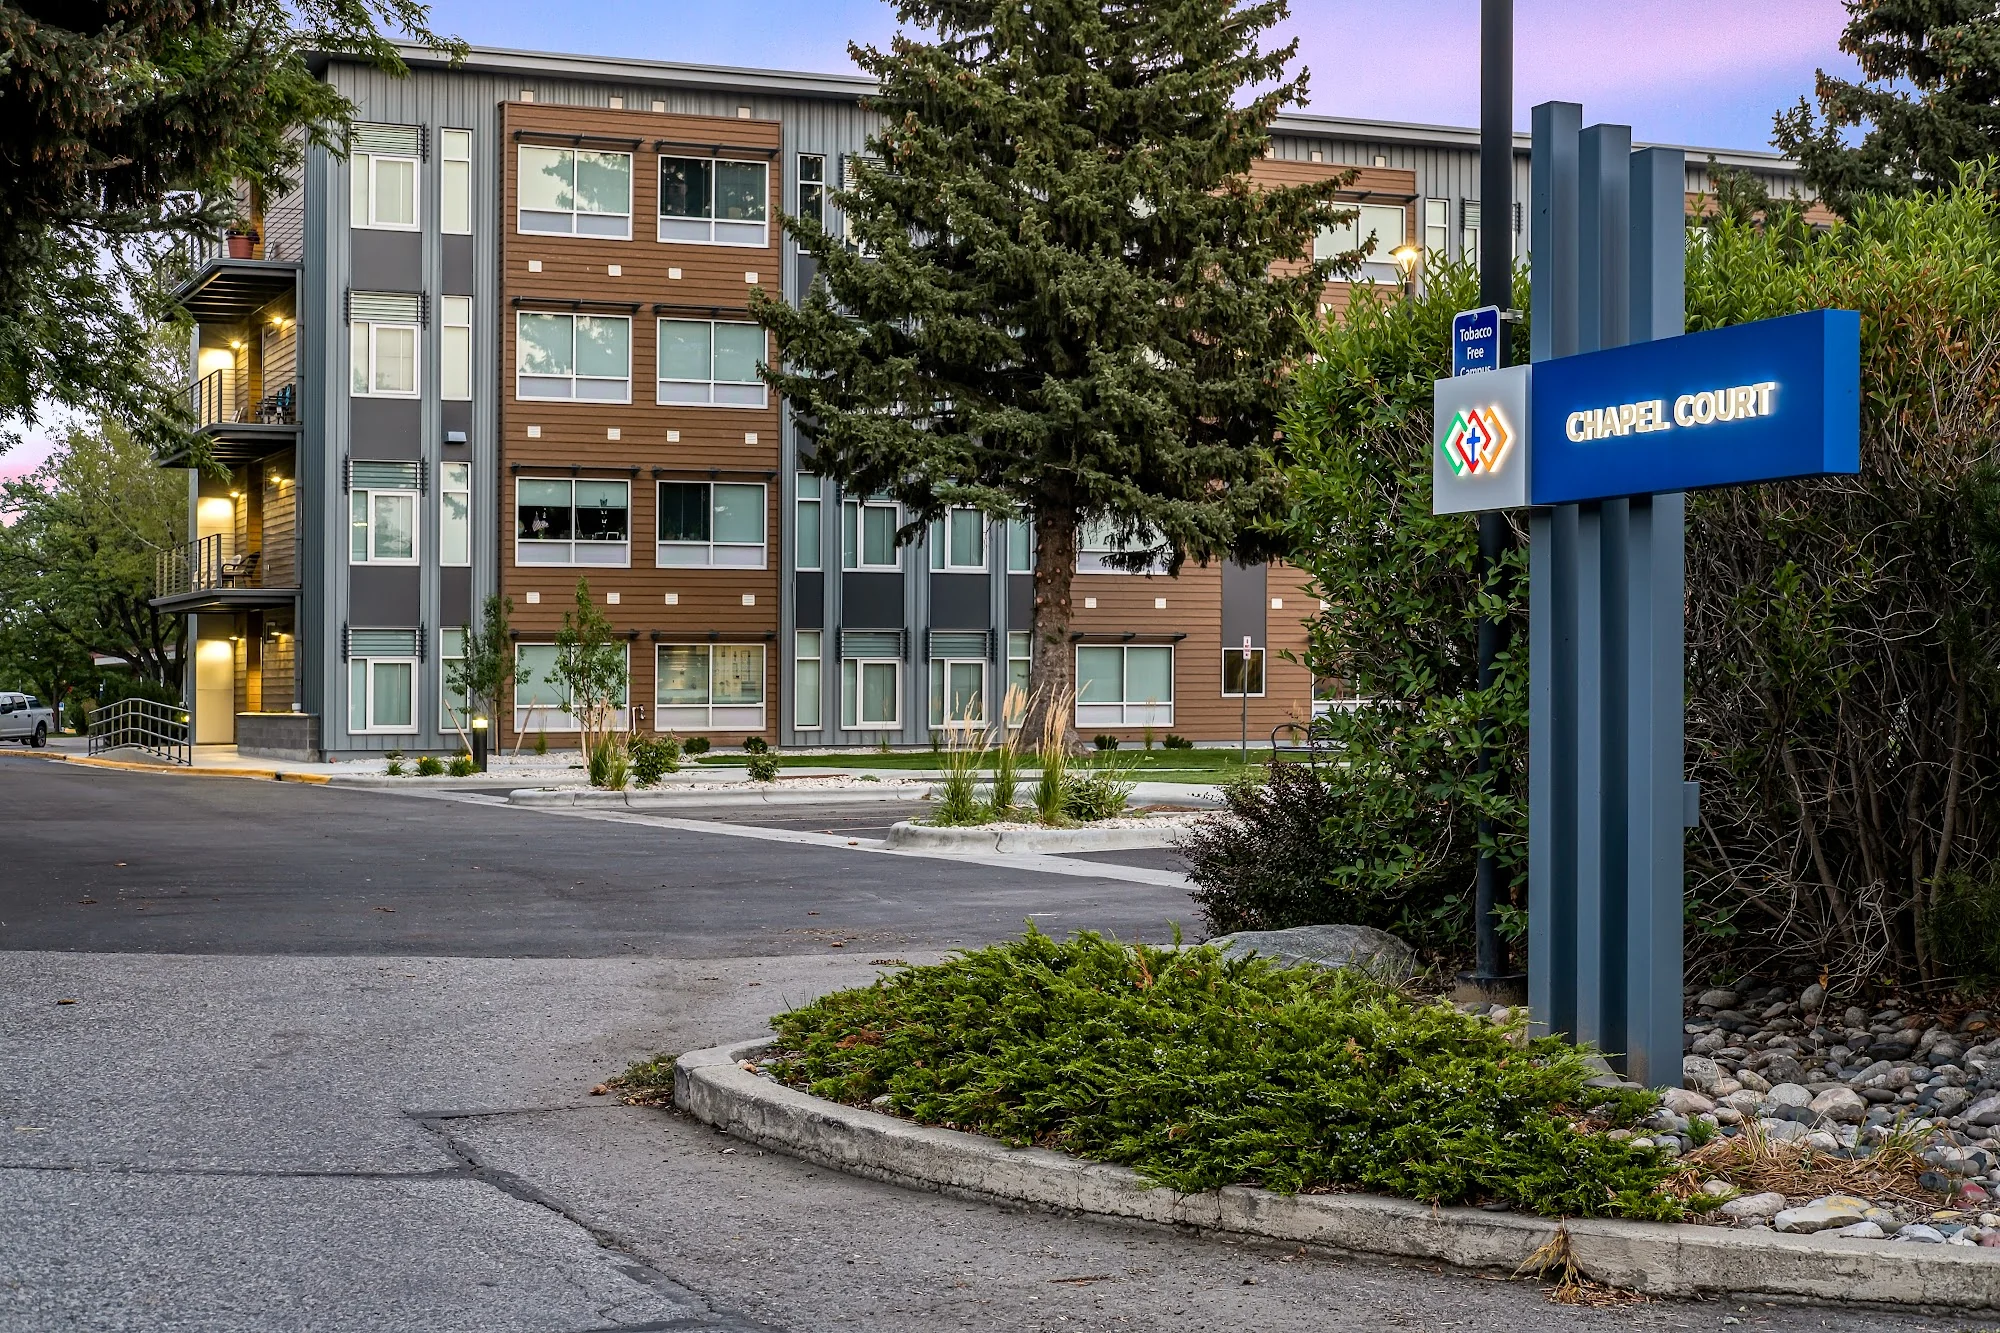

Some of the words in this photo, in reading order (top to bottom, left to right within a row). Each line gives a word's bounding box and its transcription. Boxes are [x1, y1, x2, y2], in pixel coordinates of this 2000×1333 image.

[1460, 326, 1492, 342] Tobacco
[1467, 346, 1484, 360] Free
[1565, 399, 1671, 443] CHAPEL
[1673, 381, 1776, 427] COURT
